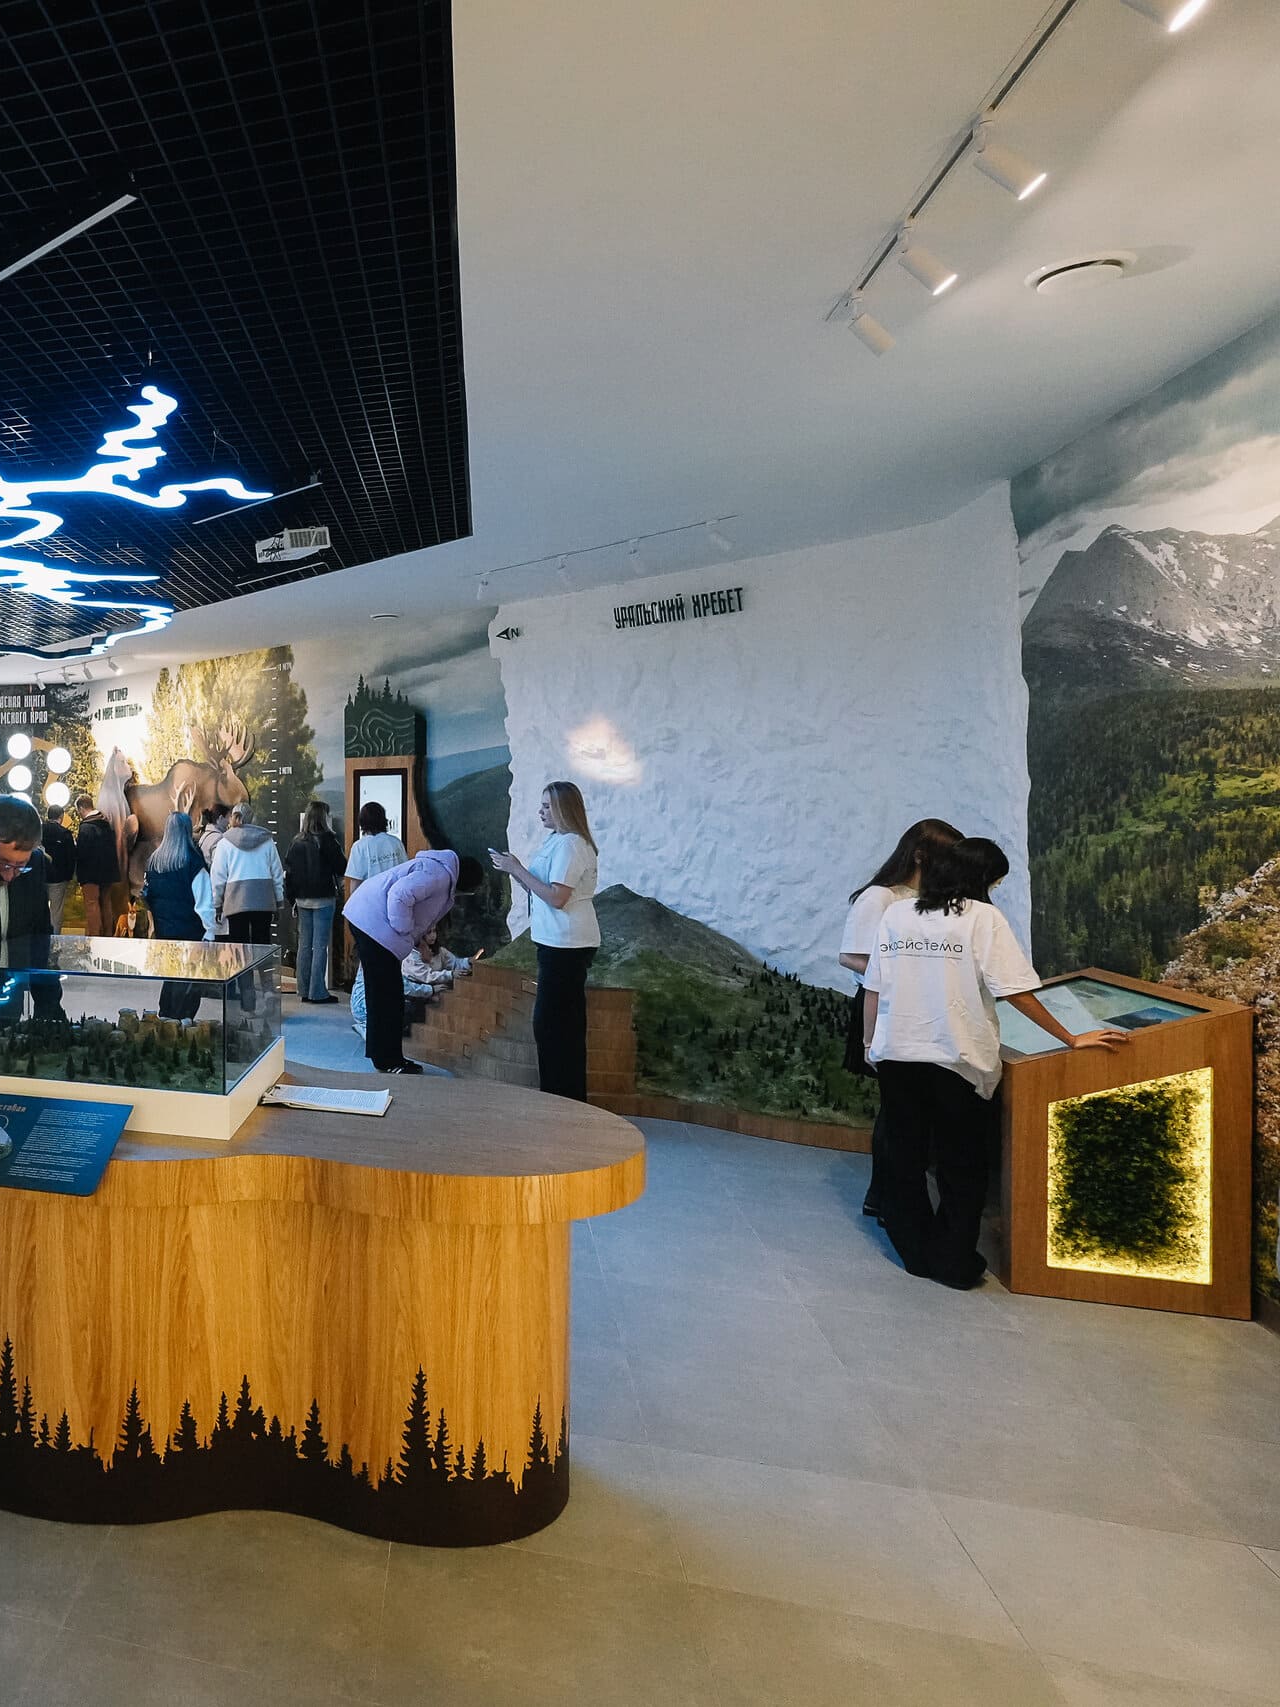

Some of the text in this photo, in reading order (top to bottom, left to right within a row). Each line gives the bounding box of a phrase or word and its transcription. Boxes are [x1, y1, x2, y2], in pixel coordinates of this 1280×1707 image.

[613, 587, 743, 629] УРАЛЬСКИЙ ХРЕБЕТ
[510, 627, 519, 638] N
[24, 694, 46, 708] КНИГА
[30, 710, 48, 724] КРАЯ
